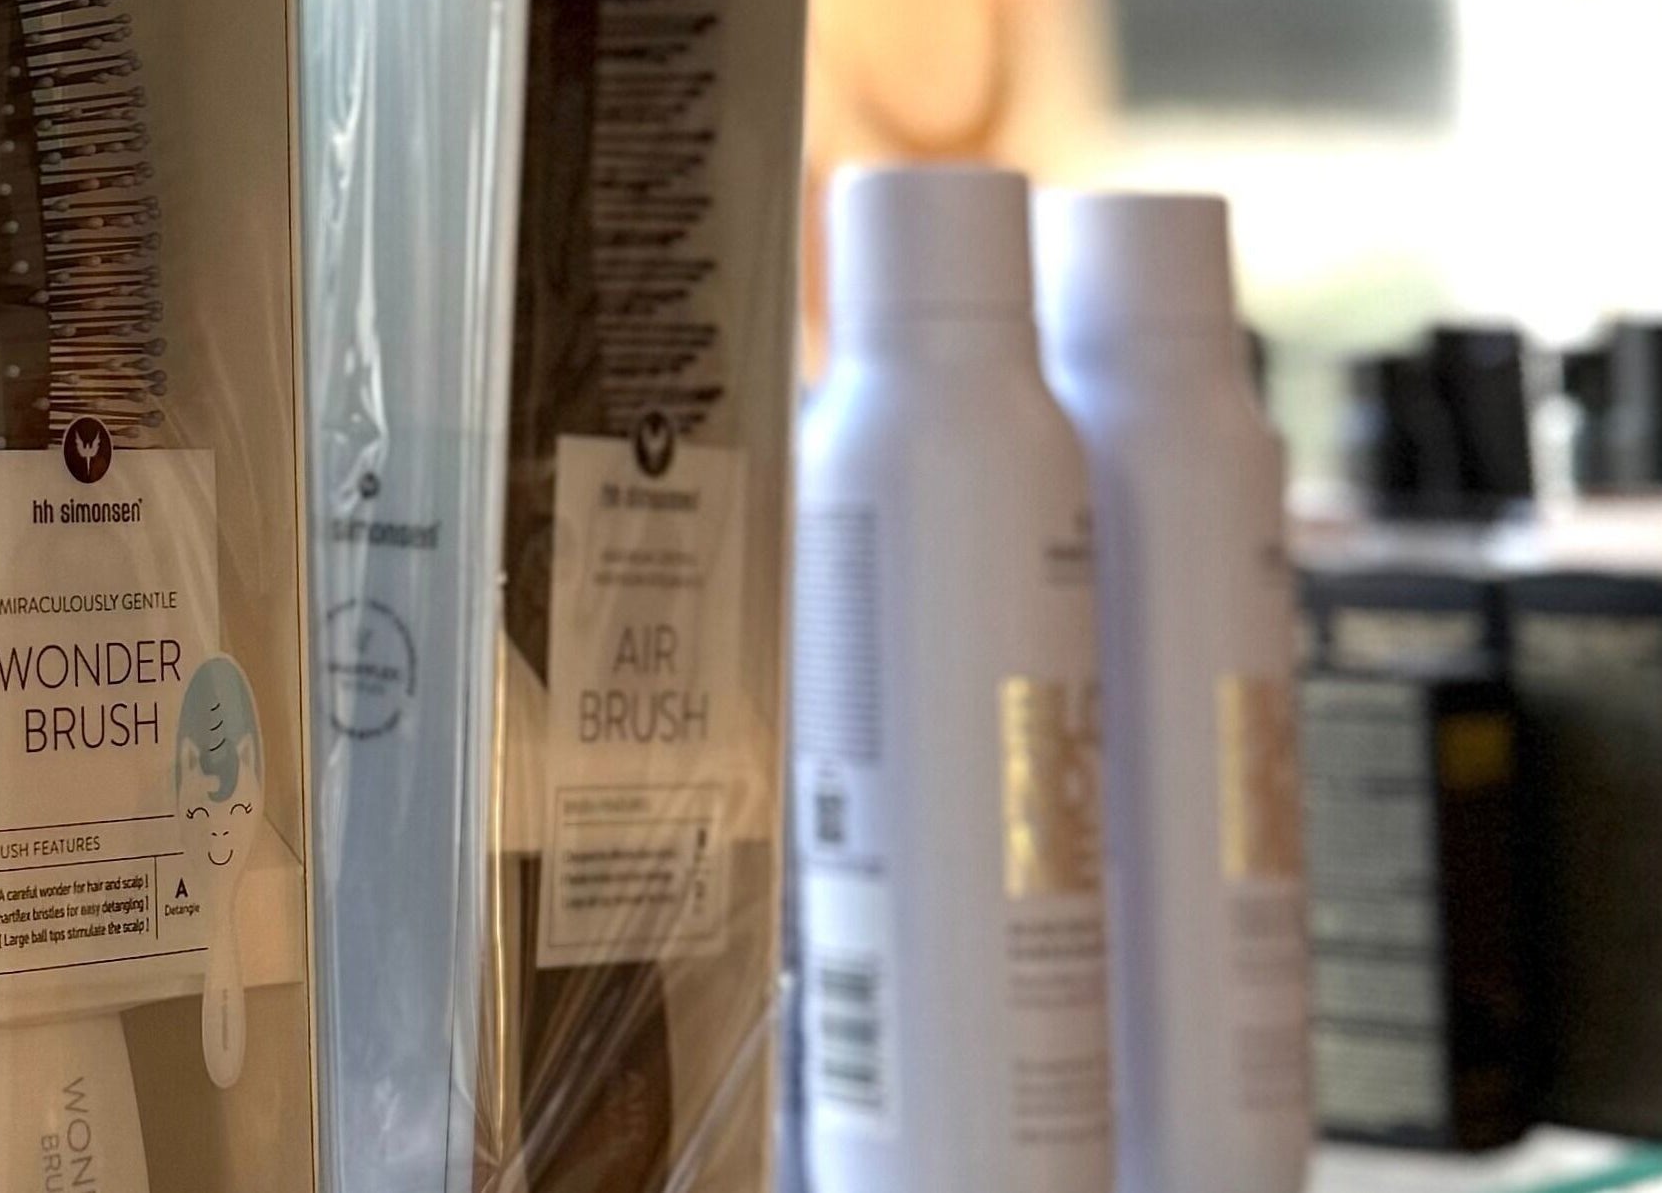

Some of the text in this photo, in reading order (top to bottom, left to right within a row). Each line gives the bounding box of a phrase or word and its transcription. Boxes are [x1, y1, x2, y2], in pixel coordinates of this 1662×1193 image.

[32, 497, 141, 525] hh simonsen
[121, 591, 178, 611] GENTLE
[613, 624, 678, 675] AIR
[25, 701, 159, 754] BRUSH
[579, 689, 709, 744] BRUSH
[33, 836, 101, 857] FEATURES
[6, 885, 38, 901] careful
[39, 881, 71, 897] wonder
[72, 880, 86, 895] for
[87, 878, 104, 893] hair
[105, 877, 121, 891] and
[122, 876, 144, 892] scalp
[174, 878, 189, 899] A
[32, 904, 66, 921] bristles
[66, 903, 79, 918] for
[101, 898, 144, 916] detangling
[164, 903, 201, 918] Detangle
[3, 919, 144, 949] Large ball tips stimulate the scalp
[61, 1076, 96, 1193] WON
